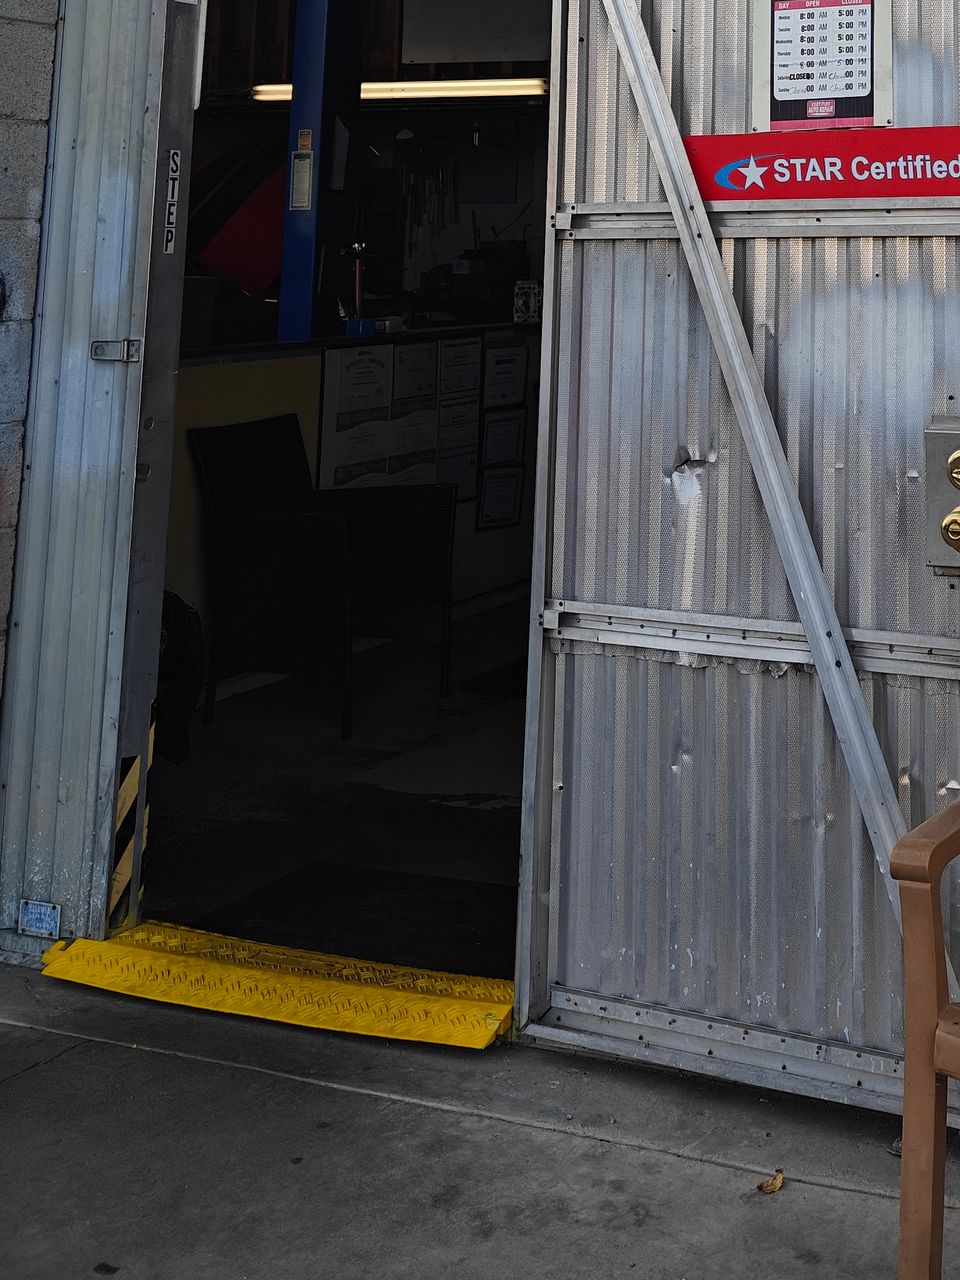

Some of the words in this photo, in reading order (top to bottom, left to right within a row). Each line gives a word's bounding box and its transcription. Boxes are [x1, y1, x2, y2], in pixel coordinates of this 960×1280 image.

[818, 23, 828, 31] AM
[818, 35, 828, 43] AM
[773, 157, 844, 183] STAR
[165, 151, 179, 252] STEP
